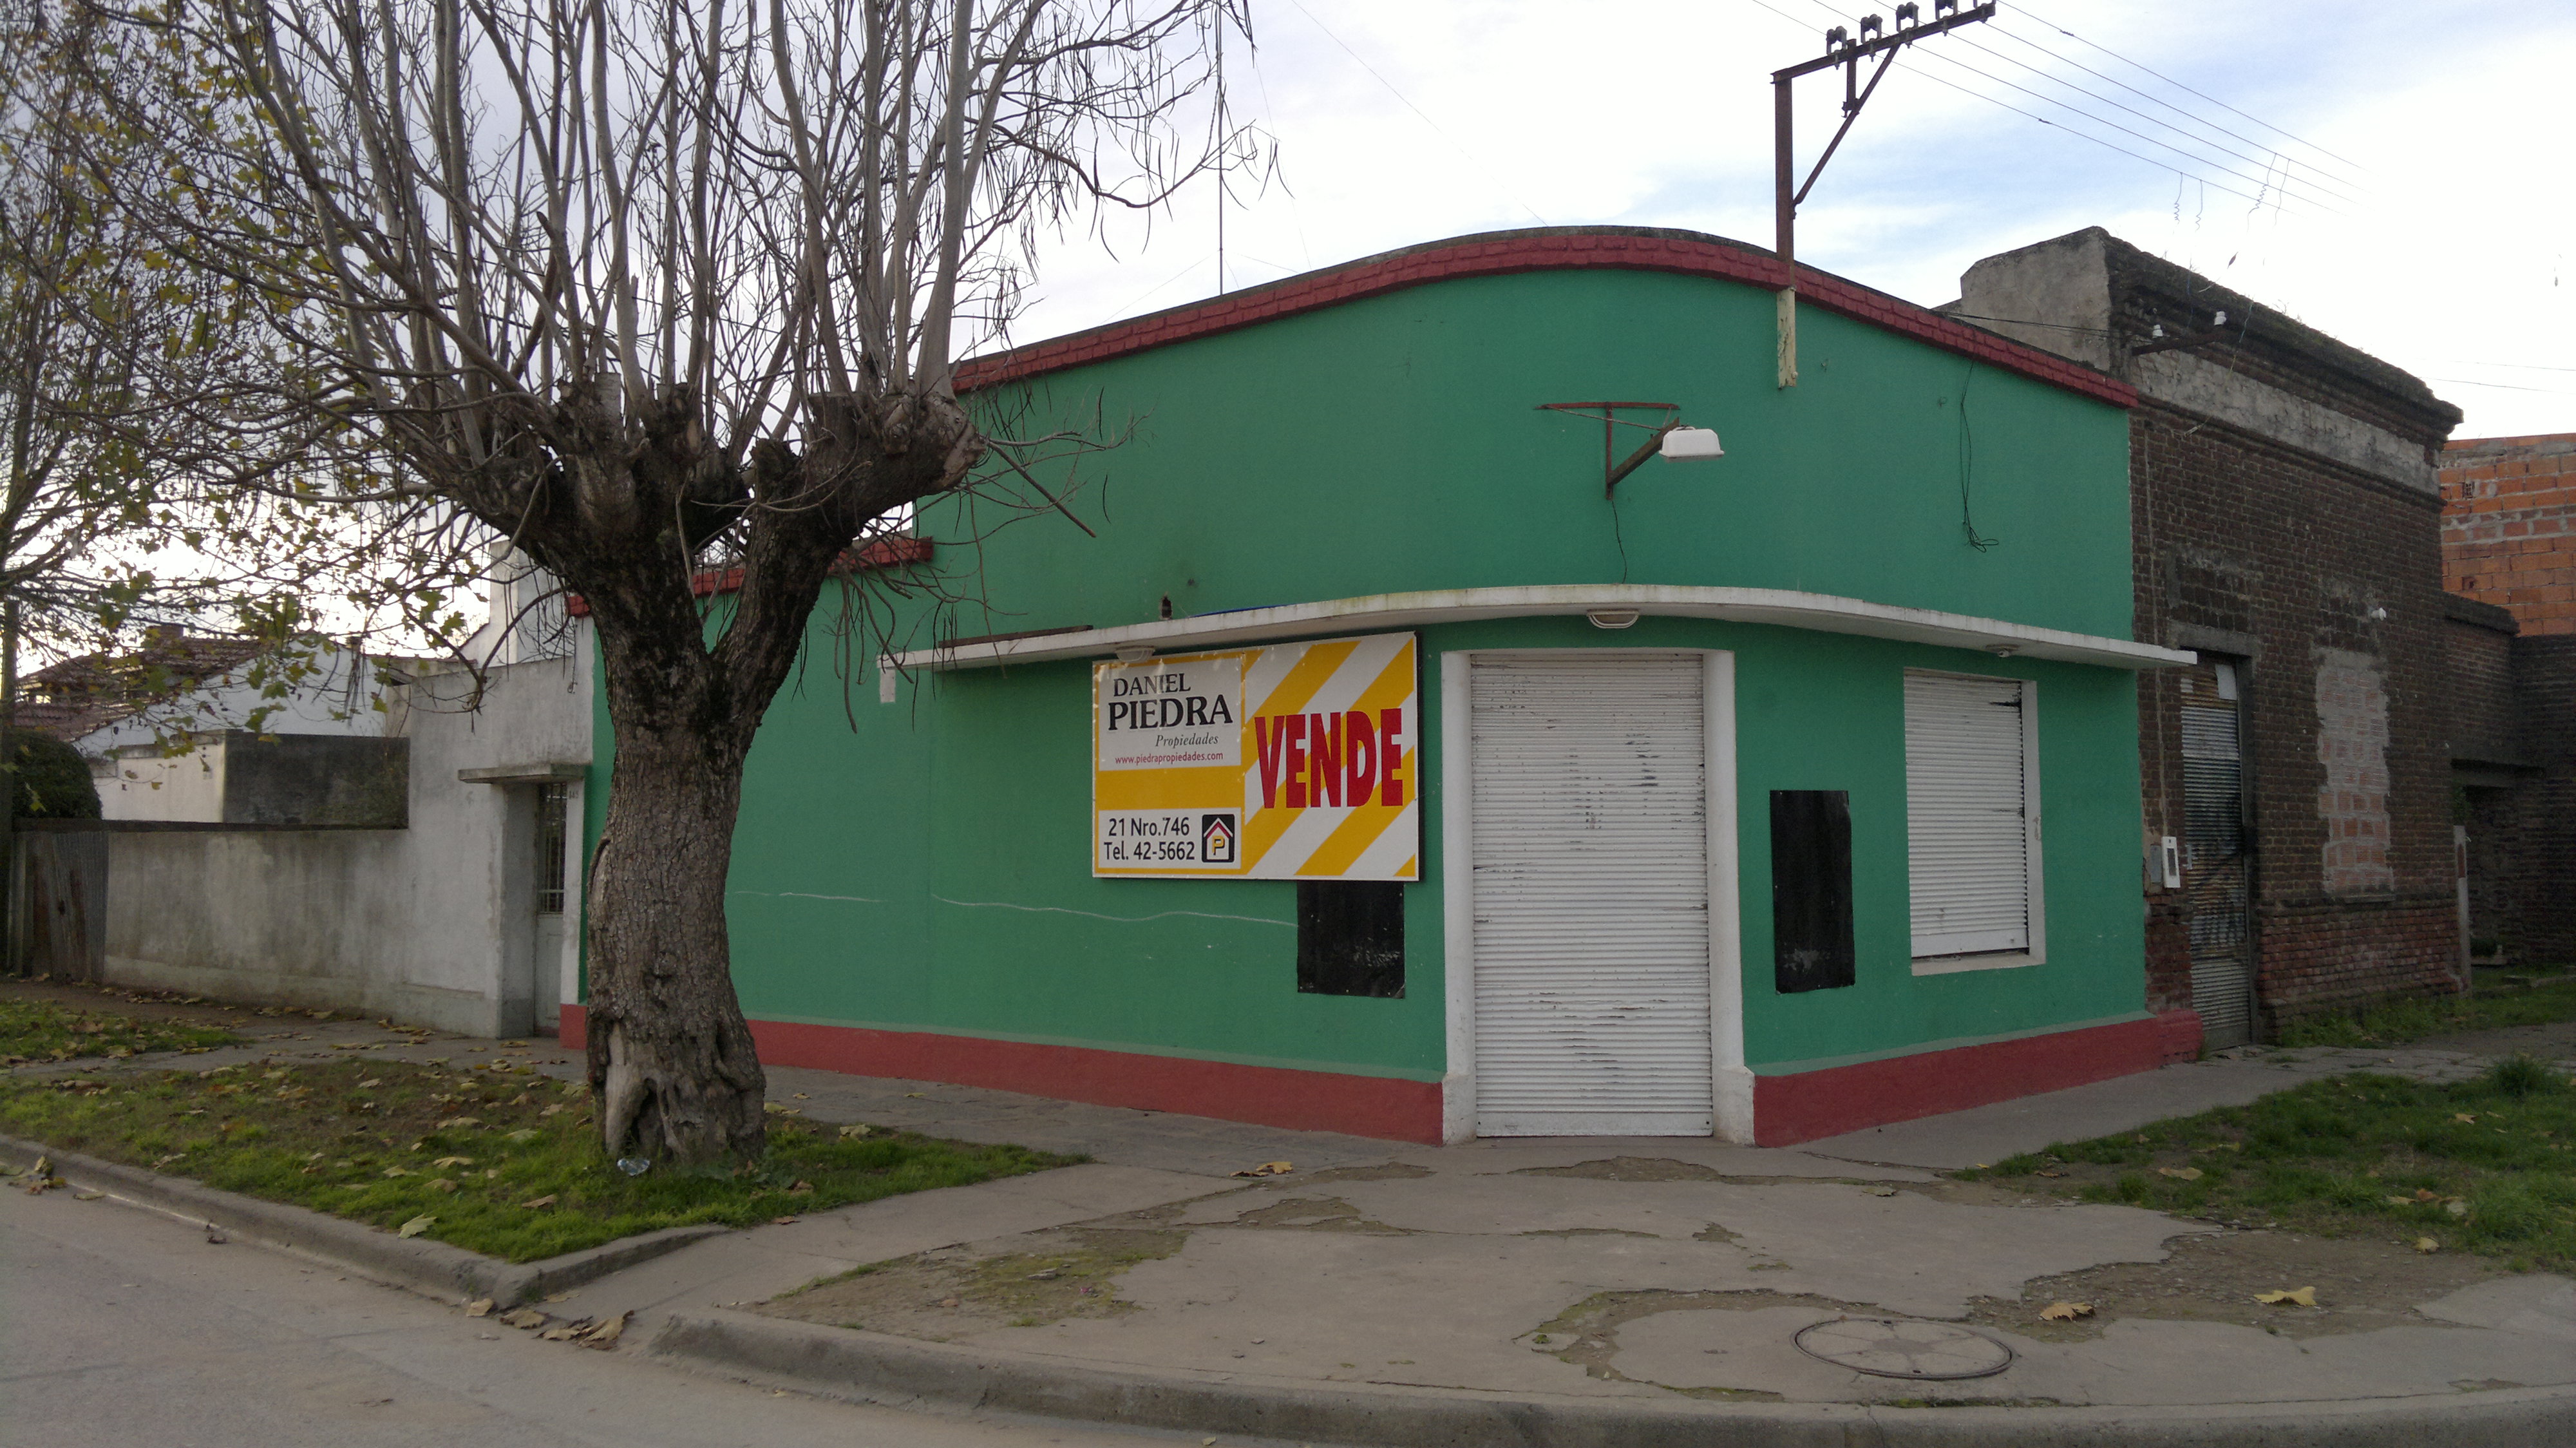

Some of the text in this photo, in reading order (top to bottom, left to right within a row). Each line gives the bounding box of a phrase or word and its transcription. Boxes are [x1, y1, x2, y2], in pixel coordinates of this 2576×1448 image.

[1113, 673, 1191, 696] DANIEL
[1108, 694, 1233, 730] PIEDRA
[1155, 732, 1218, 748] Propiedades
[1115, 752, 1224, 765] www.piedrapropiedades.com
[1255, 708, 1403, 808] VENDE
[1108, 817, 1189, 836] 21 Nro.746
[1104, 841, 1195, 860] Tel. 42-5662
[1212, 835, 1225, 855] P
